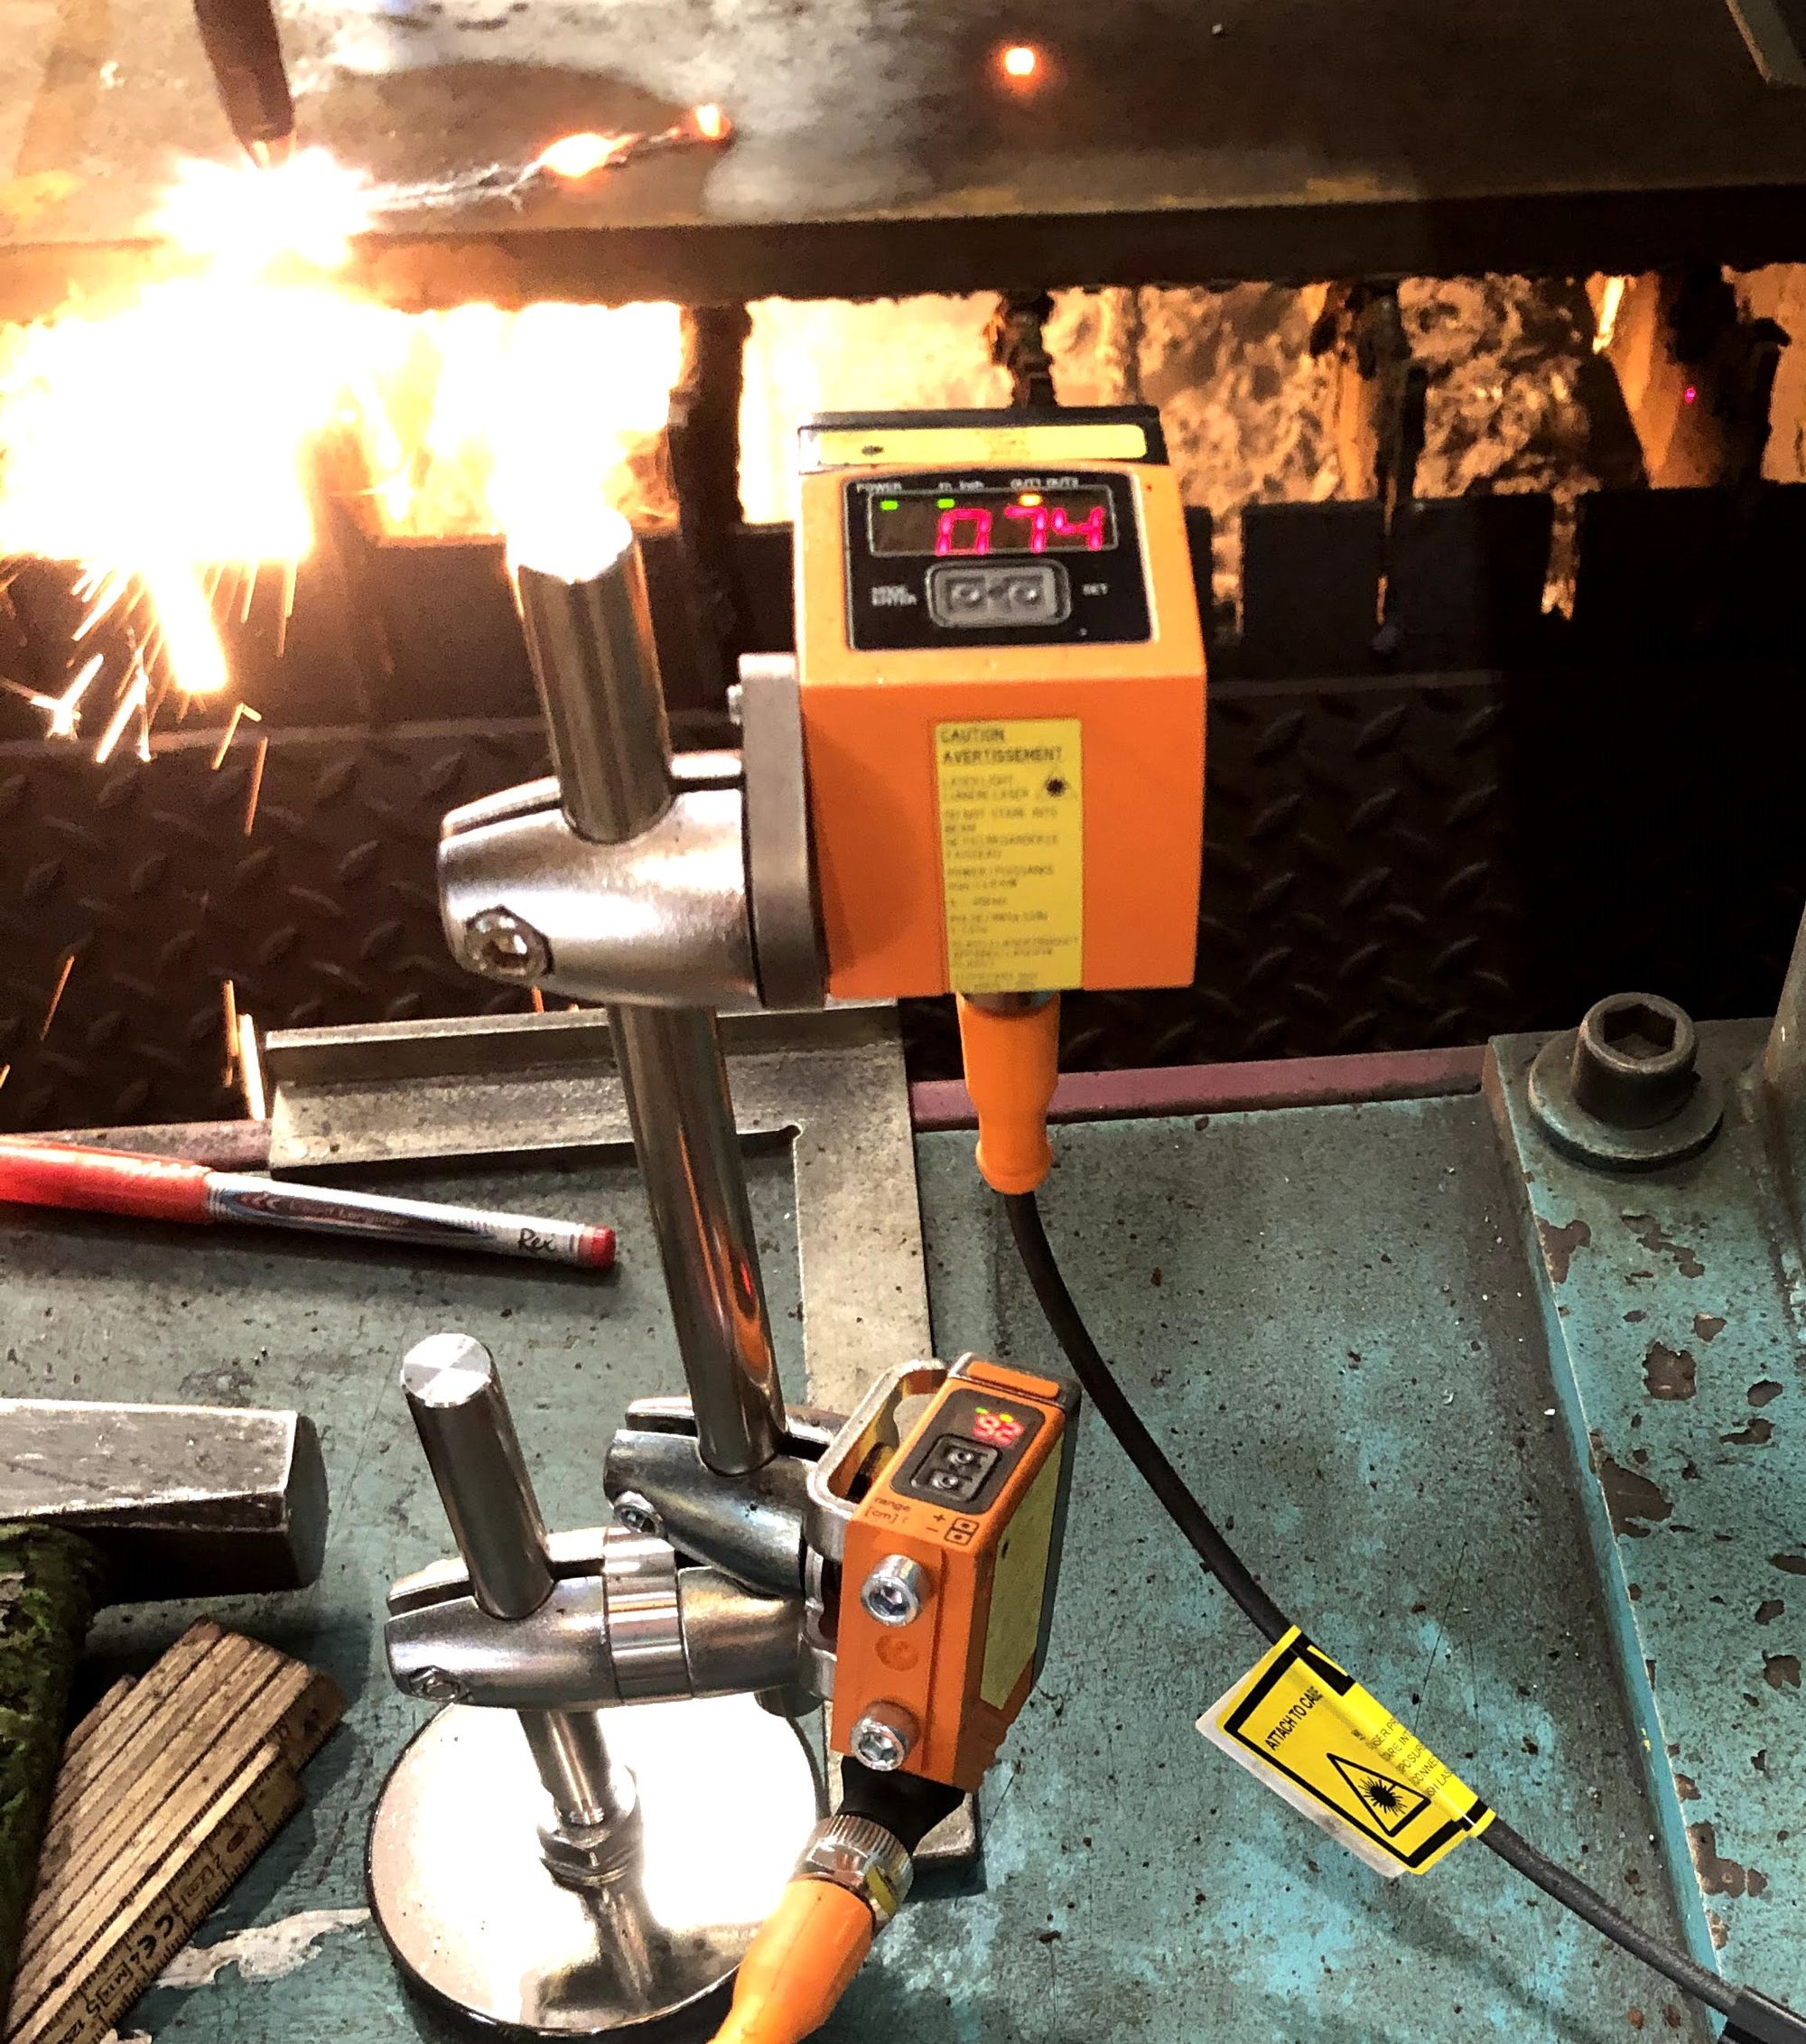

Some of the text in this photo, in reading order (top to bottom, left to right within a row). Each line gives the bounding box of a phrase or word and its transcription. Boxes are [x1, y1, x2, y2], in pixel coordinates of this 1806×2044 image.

[939, 726, 1005, 743] CAUTION
[874, 1498, 911, 1512] range
[1264, 1714, 1298, 1751] ATTACH
[1289, 1704, 1308, 1721] TO
[137, 1913, 174, 1959] CE
